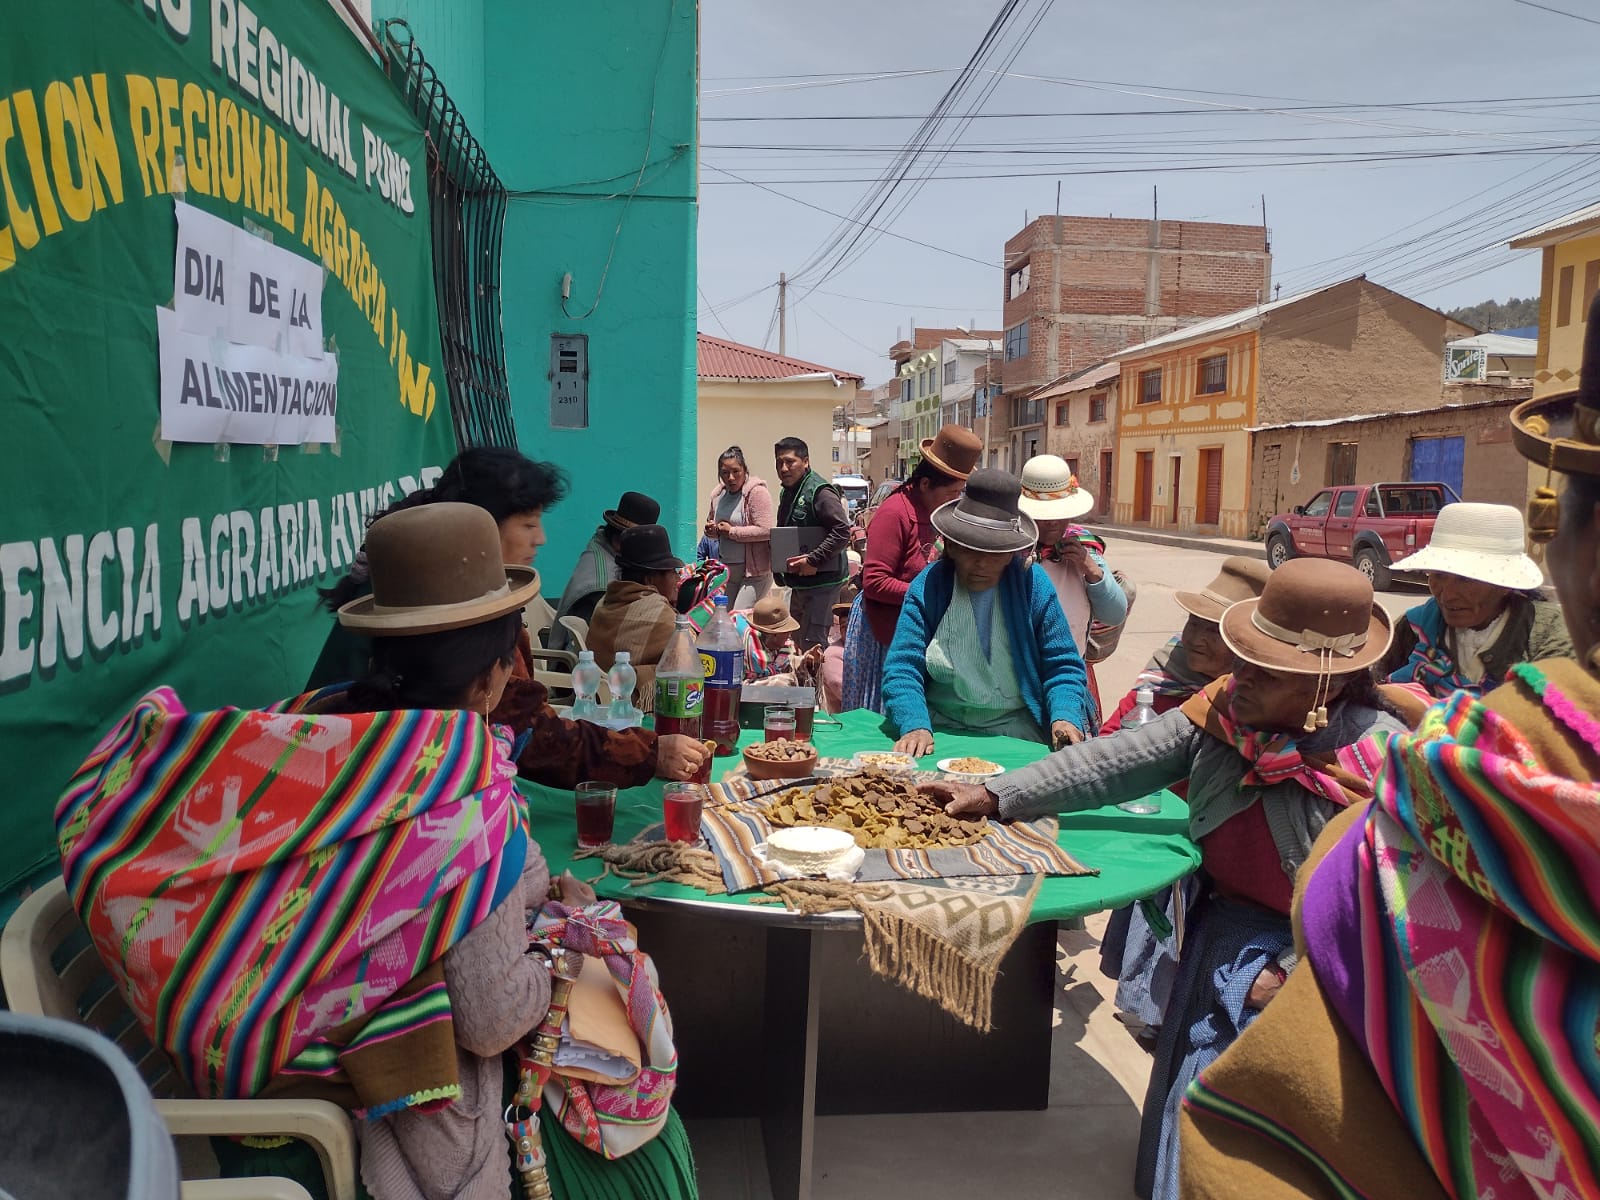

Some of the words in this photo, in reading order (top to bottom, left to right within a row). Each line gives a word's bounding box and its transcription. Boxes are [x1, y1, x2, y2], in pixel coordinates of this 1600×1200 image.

[210, 0, 357, 178] REGIONAL
[362, 123, 414, 213] PUNO
[0, 73, 124, 272] CION
[126, 74, 295, 233] REGIONAL
[303, 167, 386, 348] AGRARIA
[184, 247, 225, 305] DIA
[249, 271, 281, 319] DE
[290, 289, 312, 330] LA
[180, 358, 336, 417] ALIMENTACION
[1451, 350, 1479, 378] Sprite
[0, 522, 163, 682] ENCIA
[178, 498, 326, 621] AGRARIA
